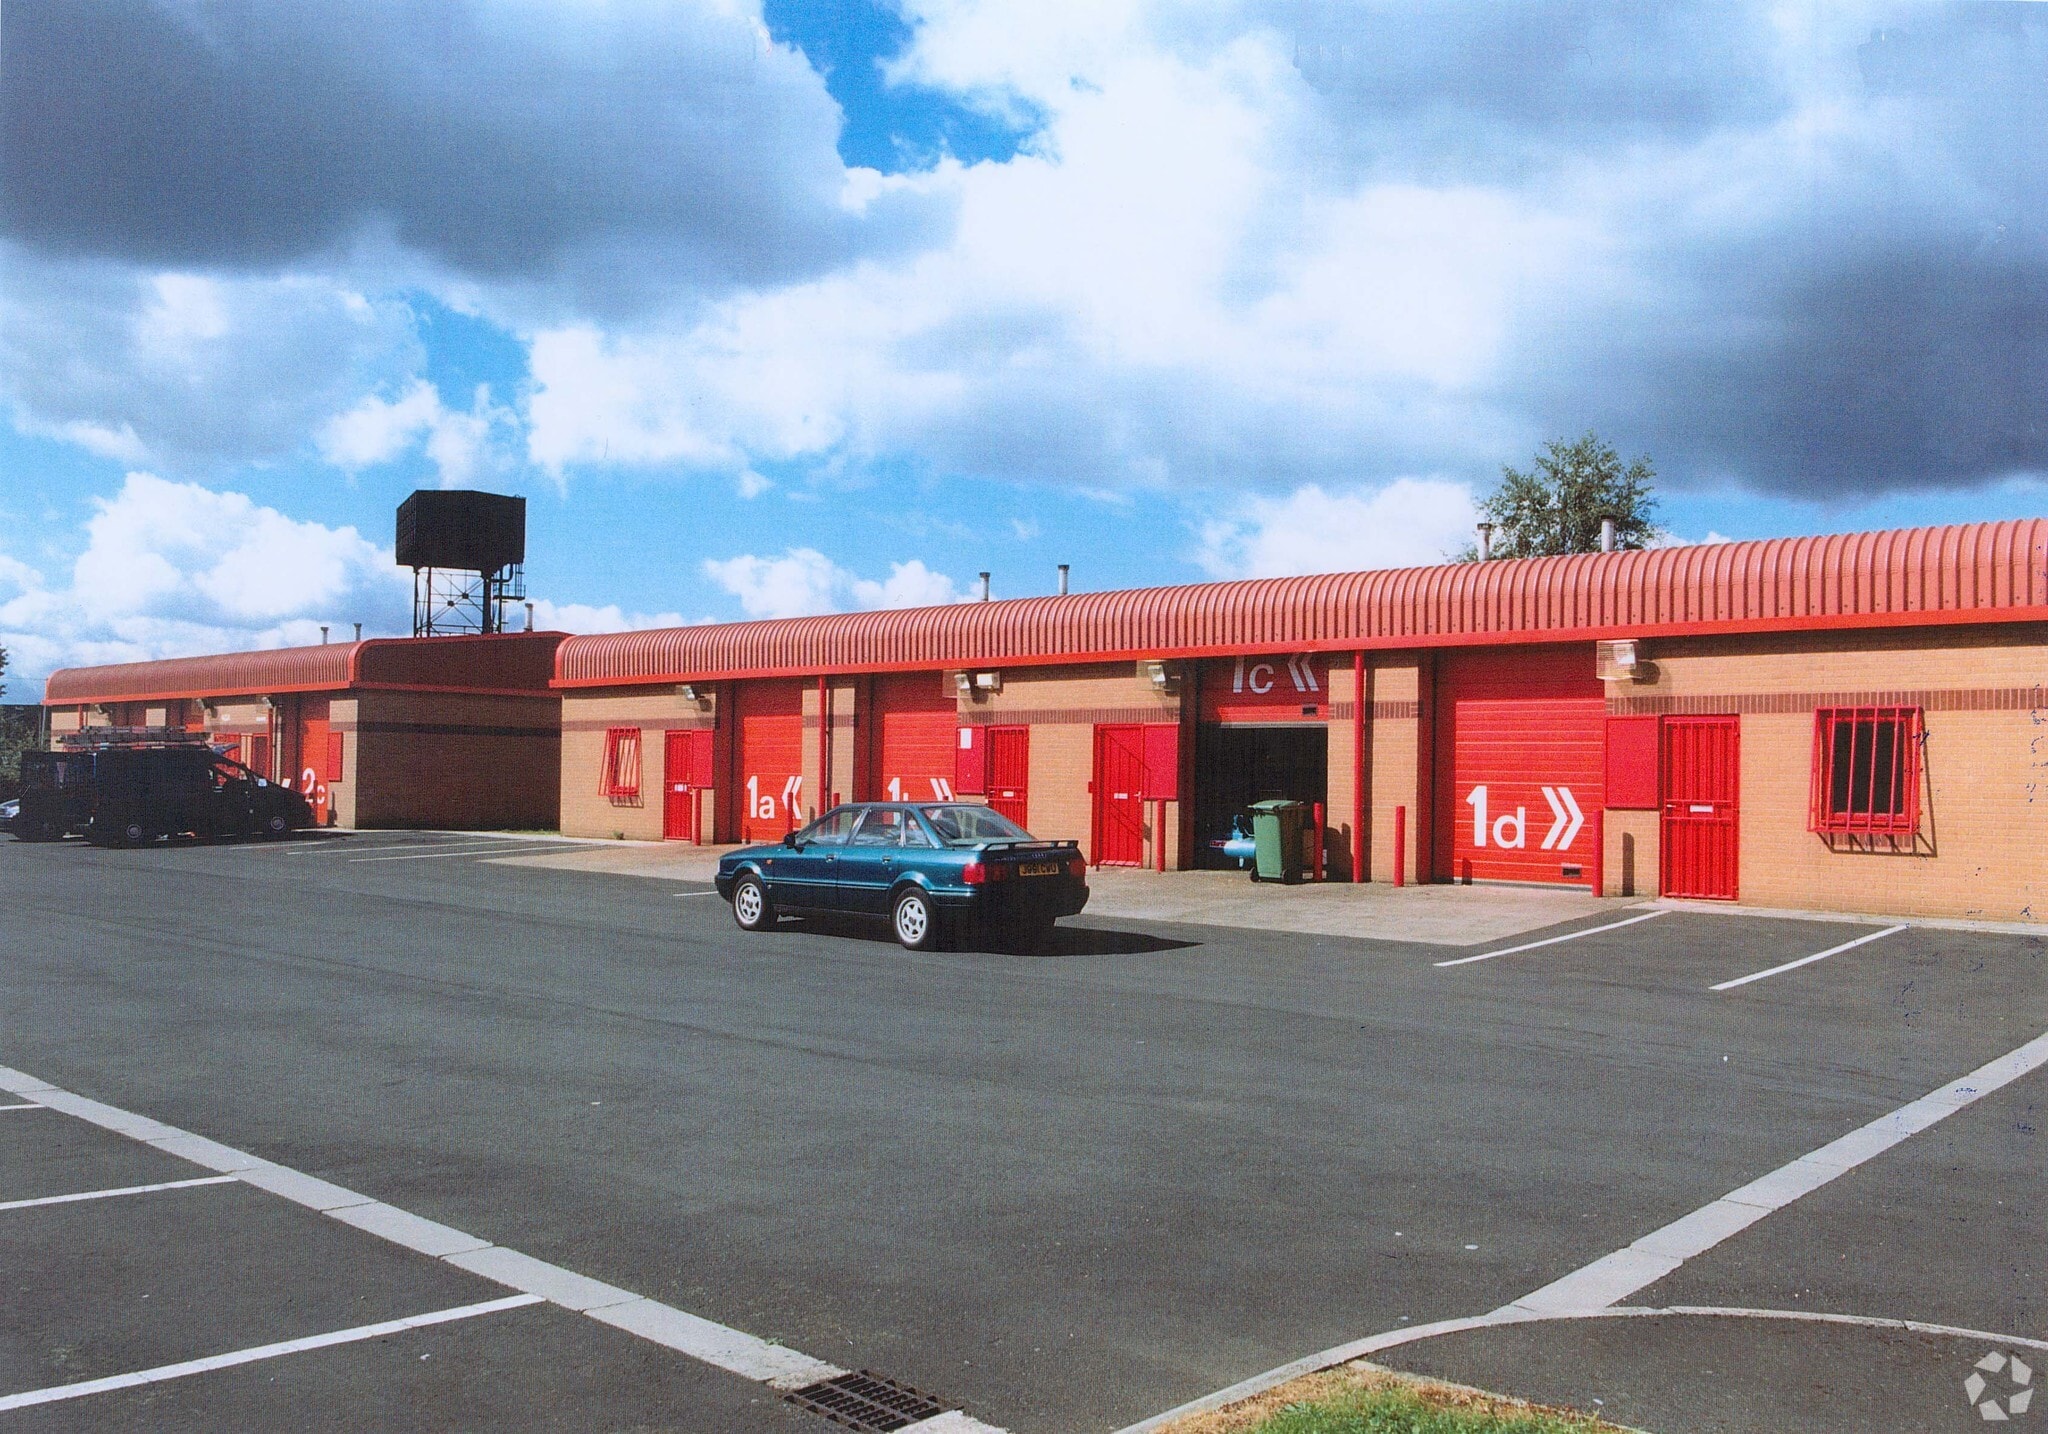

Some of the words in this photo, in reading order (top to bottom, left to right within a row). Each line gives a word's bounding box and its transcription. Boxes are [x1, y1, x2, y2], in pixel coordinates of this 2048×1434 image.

[302, 767, 326, 804] 2c
[746, 775, 775, 819] 1a
[1465, 785, 1526, 849] 1d
